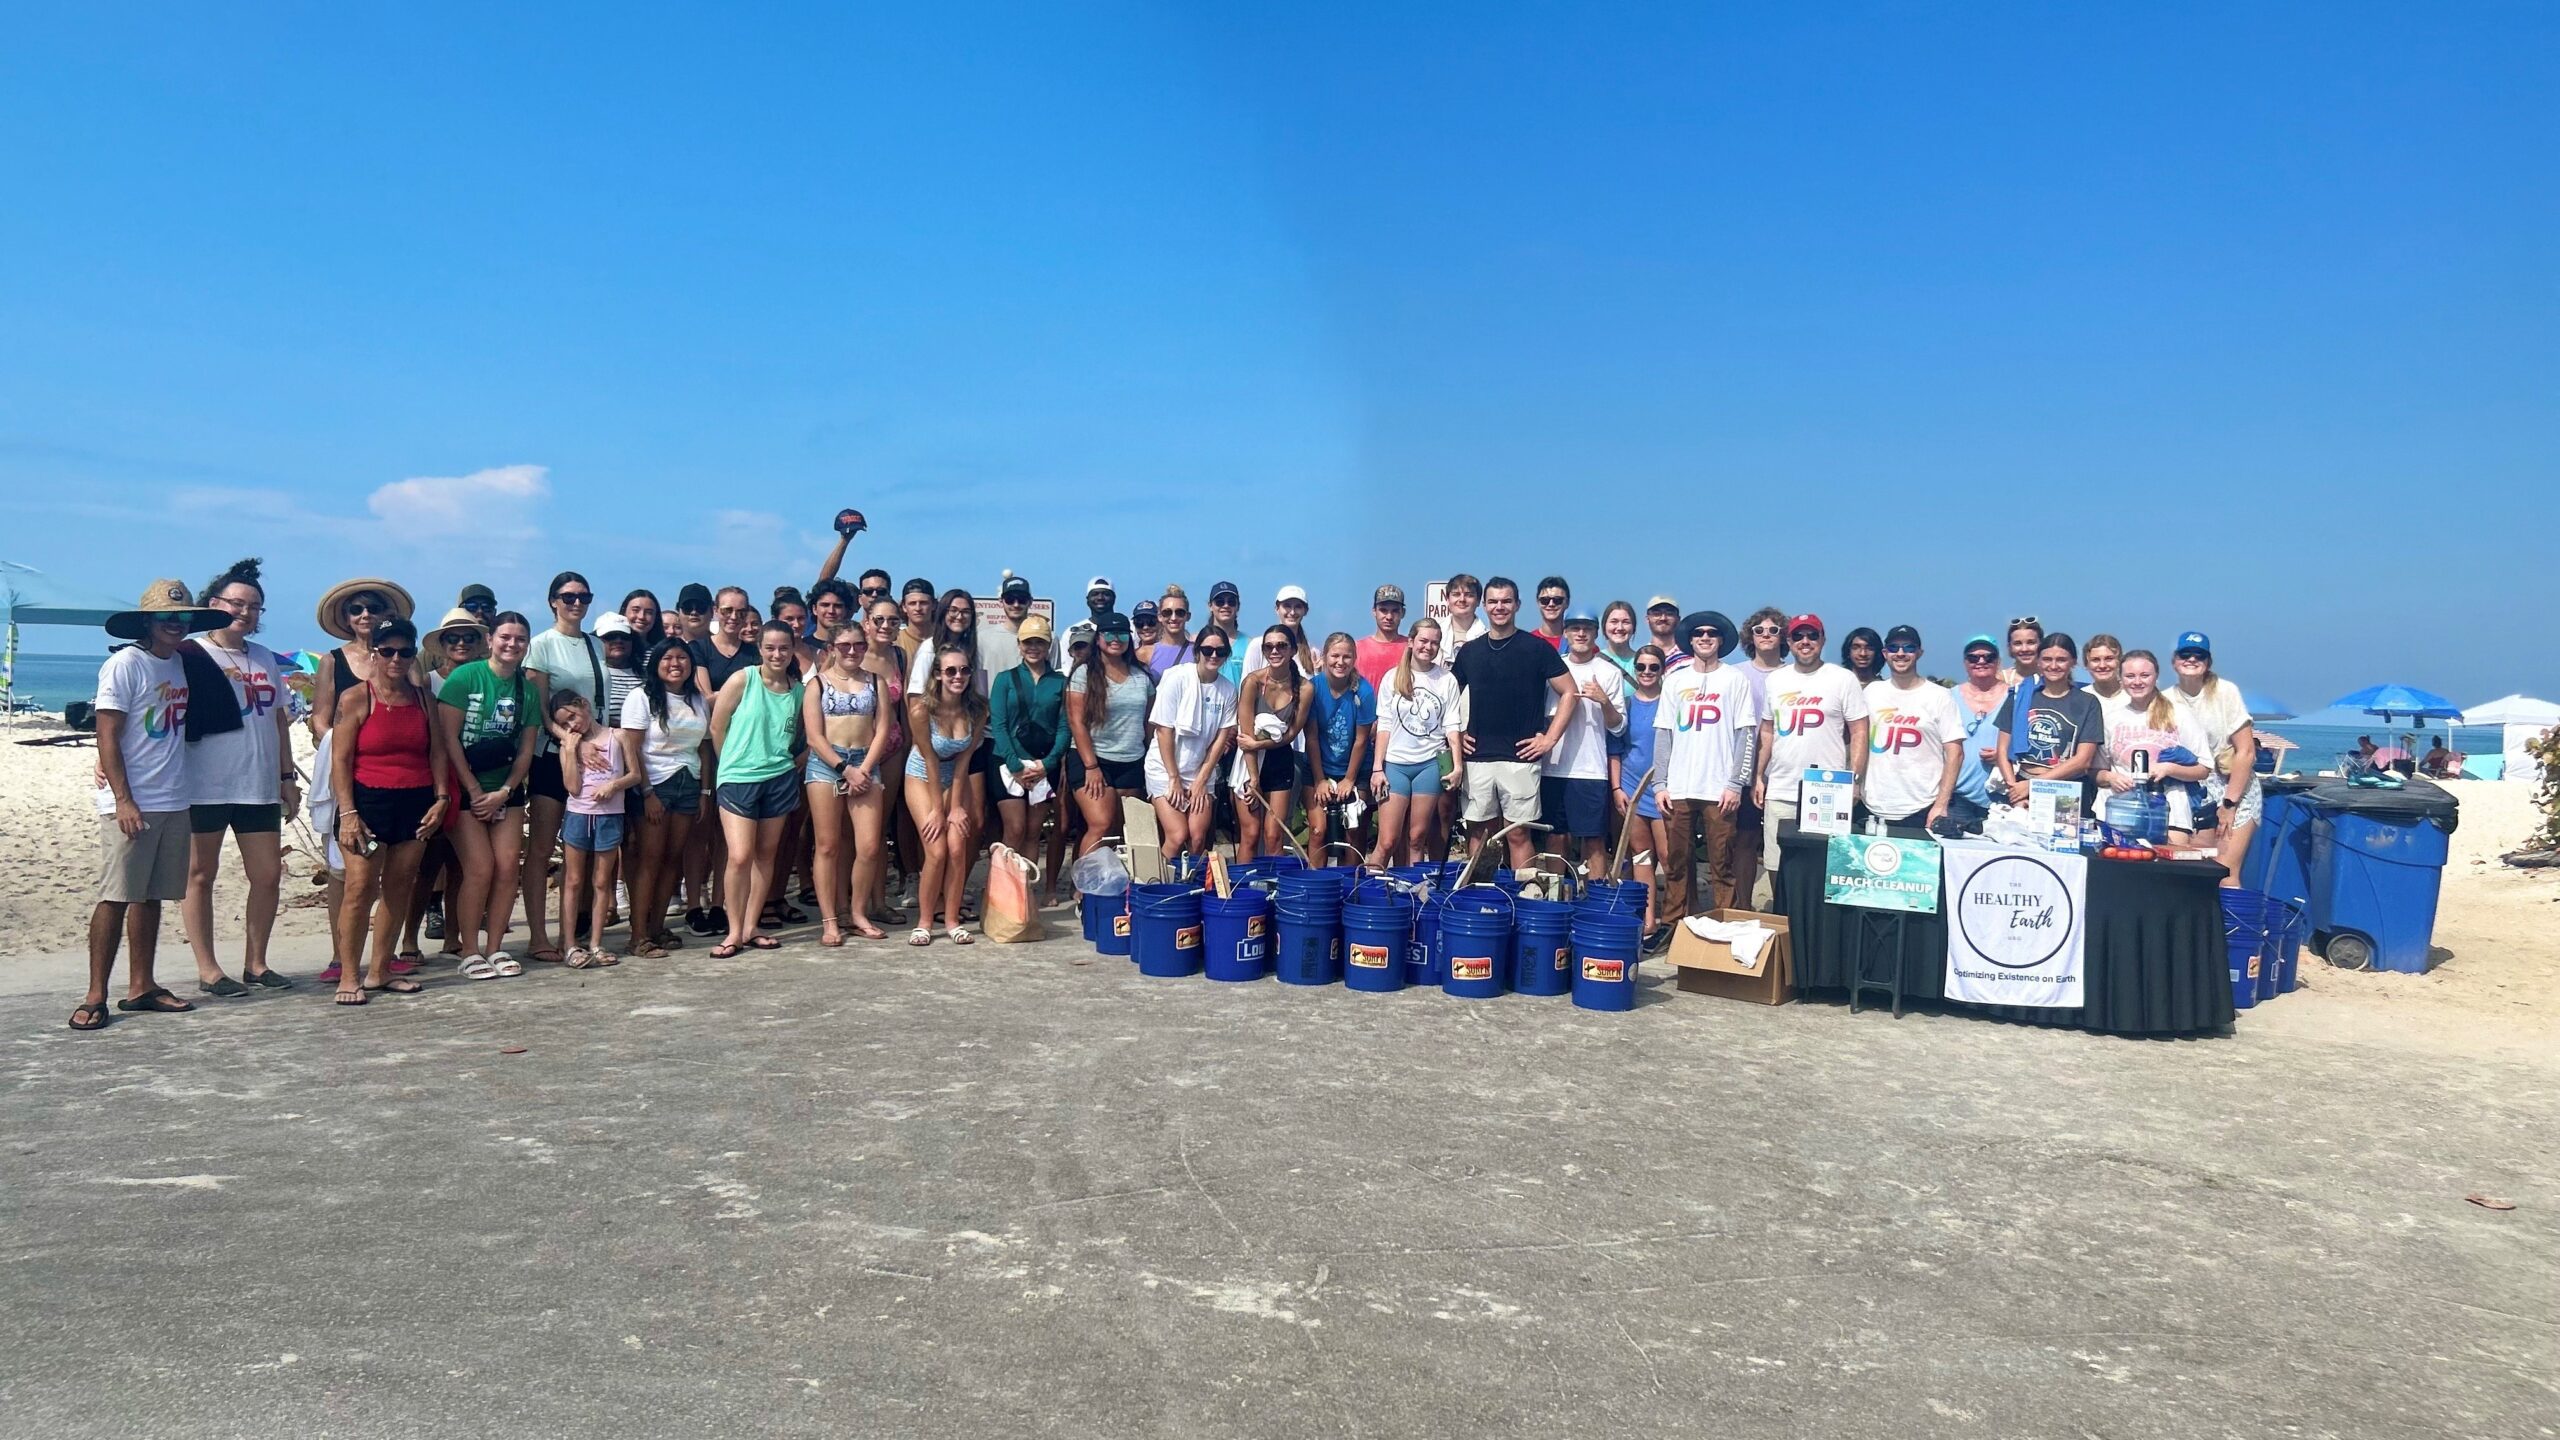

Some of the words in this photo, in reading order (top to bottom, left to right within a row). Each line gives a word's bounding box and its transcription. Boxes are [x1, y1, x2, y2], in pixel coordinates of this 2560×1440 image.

[1677, 687, 1721, 702] Team
[1775, 691, 1824, 706] Team
[1676, 704, 1722, 732] UP
[1774, 708, 1825, 737] UP
[1876, 707, 1921, 726] Team
[1868, 725, 1923, 755] UP
[1830, 874, 1871, 888] BEACH
[1874, 879, 1933, 894] CLEANUP
[1974, 892, 2043, 907] HEALTHY
[2009, 905, 2054, 930] Earth
[1953, 967, 1996, 981] Optimizing
[1997, 972, 2040, 982] Existence
[2055, 975, 2077, 983] Earth
